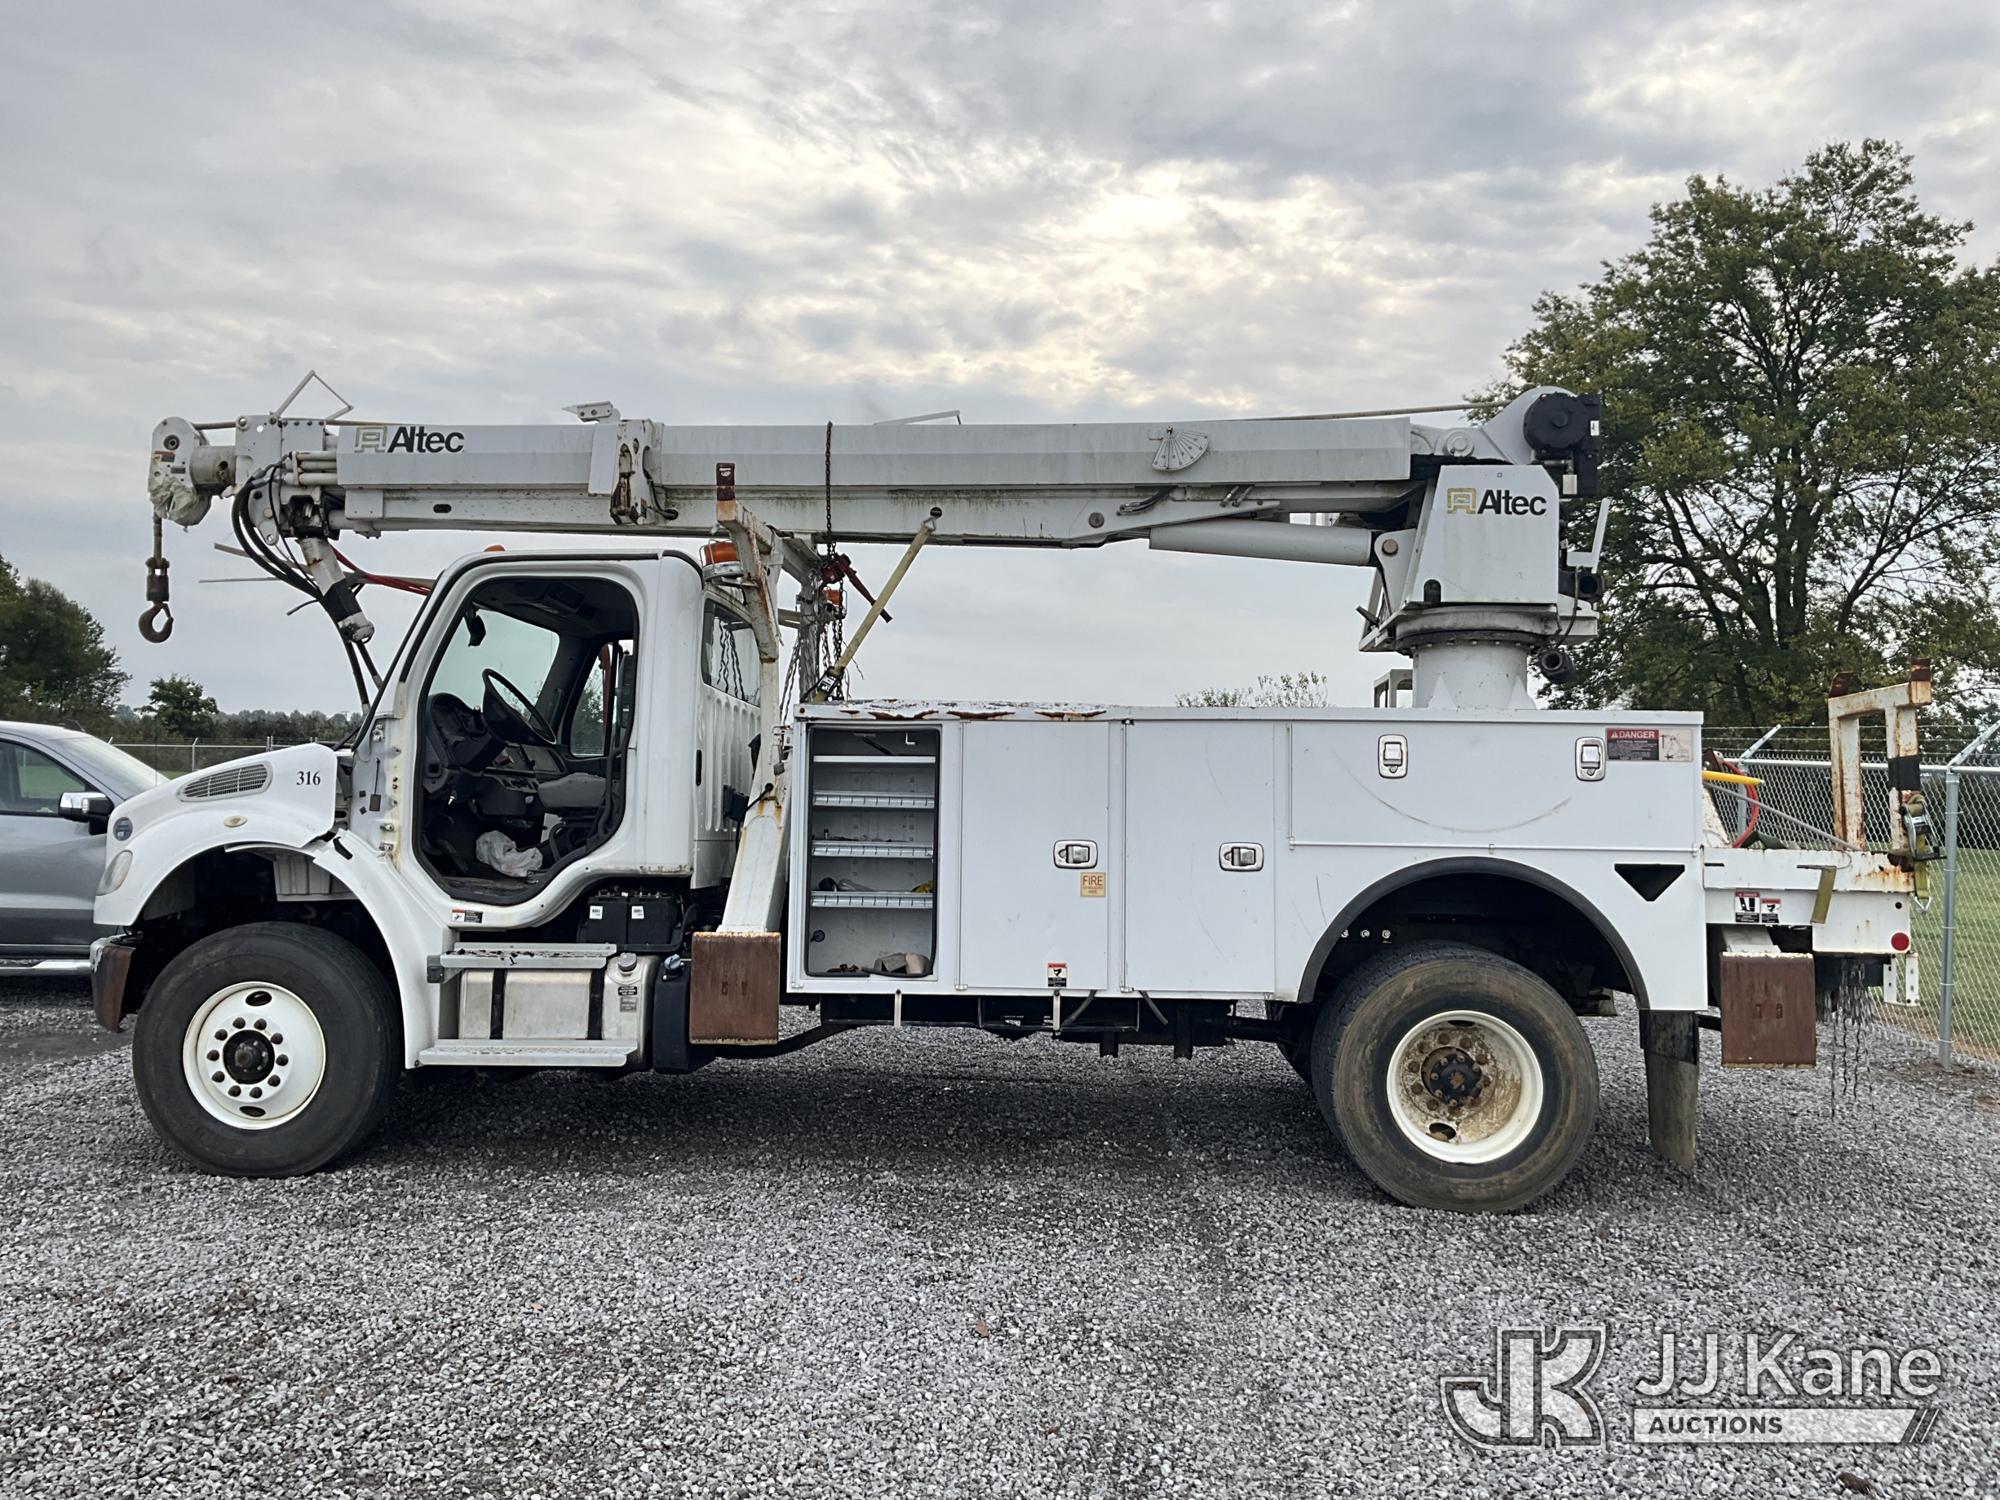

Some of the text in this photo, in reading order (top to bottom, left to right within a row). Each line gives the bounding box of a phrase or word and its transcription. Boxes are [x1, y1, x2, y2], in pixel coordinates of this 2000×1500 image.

[387, 426, 465, 454] Altec
[1477, 489, 1547, 516] Altec
[1619, 730, 1656, 739] DANGER
[296, 770, 321, 786] 316
[1082, 875, 1104, 886] FIRE
